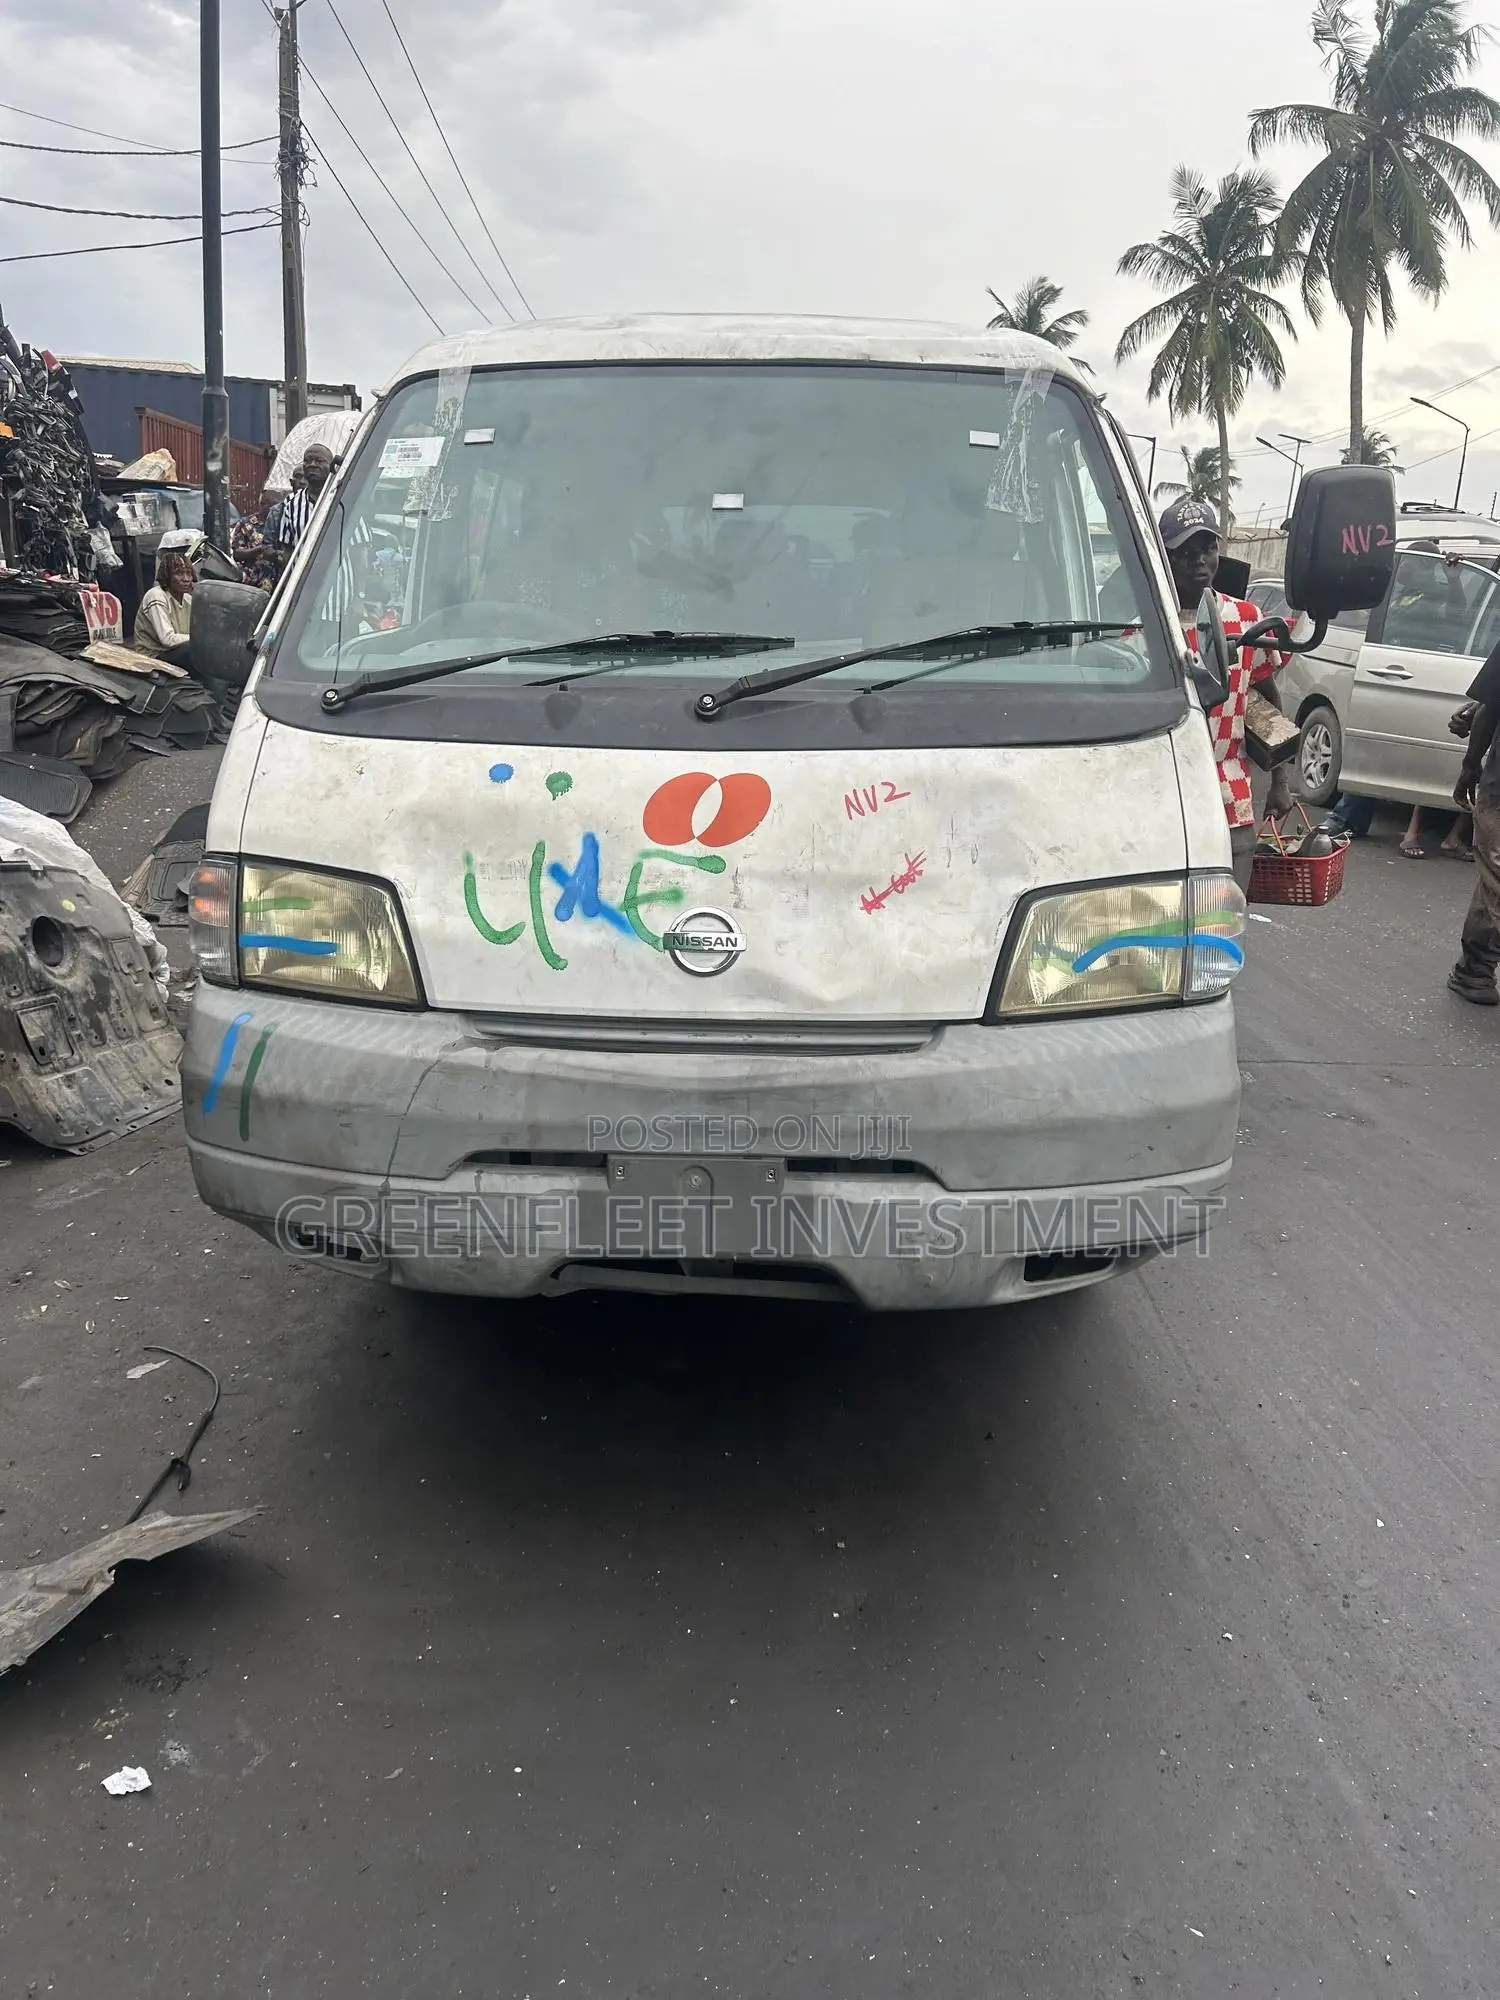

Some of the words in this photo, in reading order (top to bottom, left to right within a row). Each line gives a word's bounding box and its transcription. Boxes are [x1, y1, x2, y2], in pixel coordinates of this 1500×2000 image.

[1184, 518, 1204, 528] 2024
[1341, 524, 1394, 555] NV2
[844, 781, 912, 820] NV2
[672, 935, 738, 947] NISSAN
